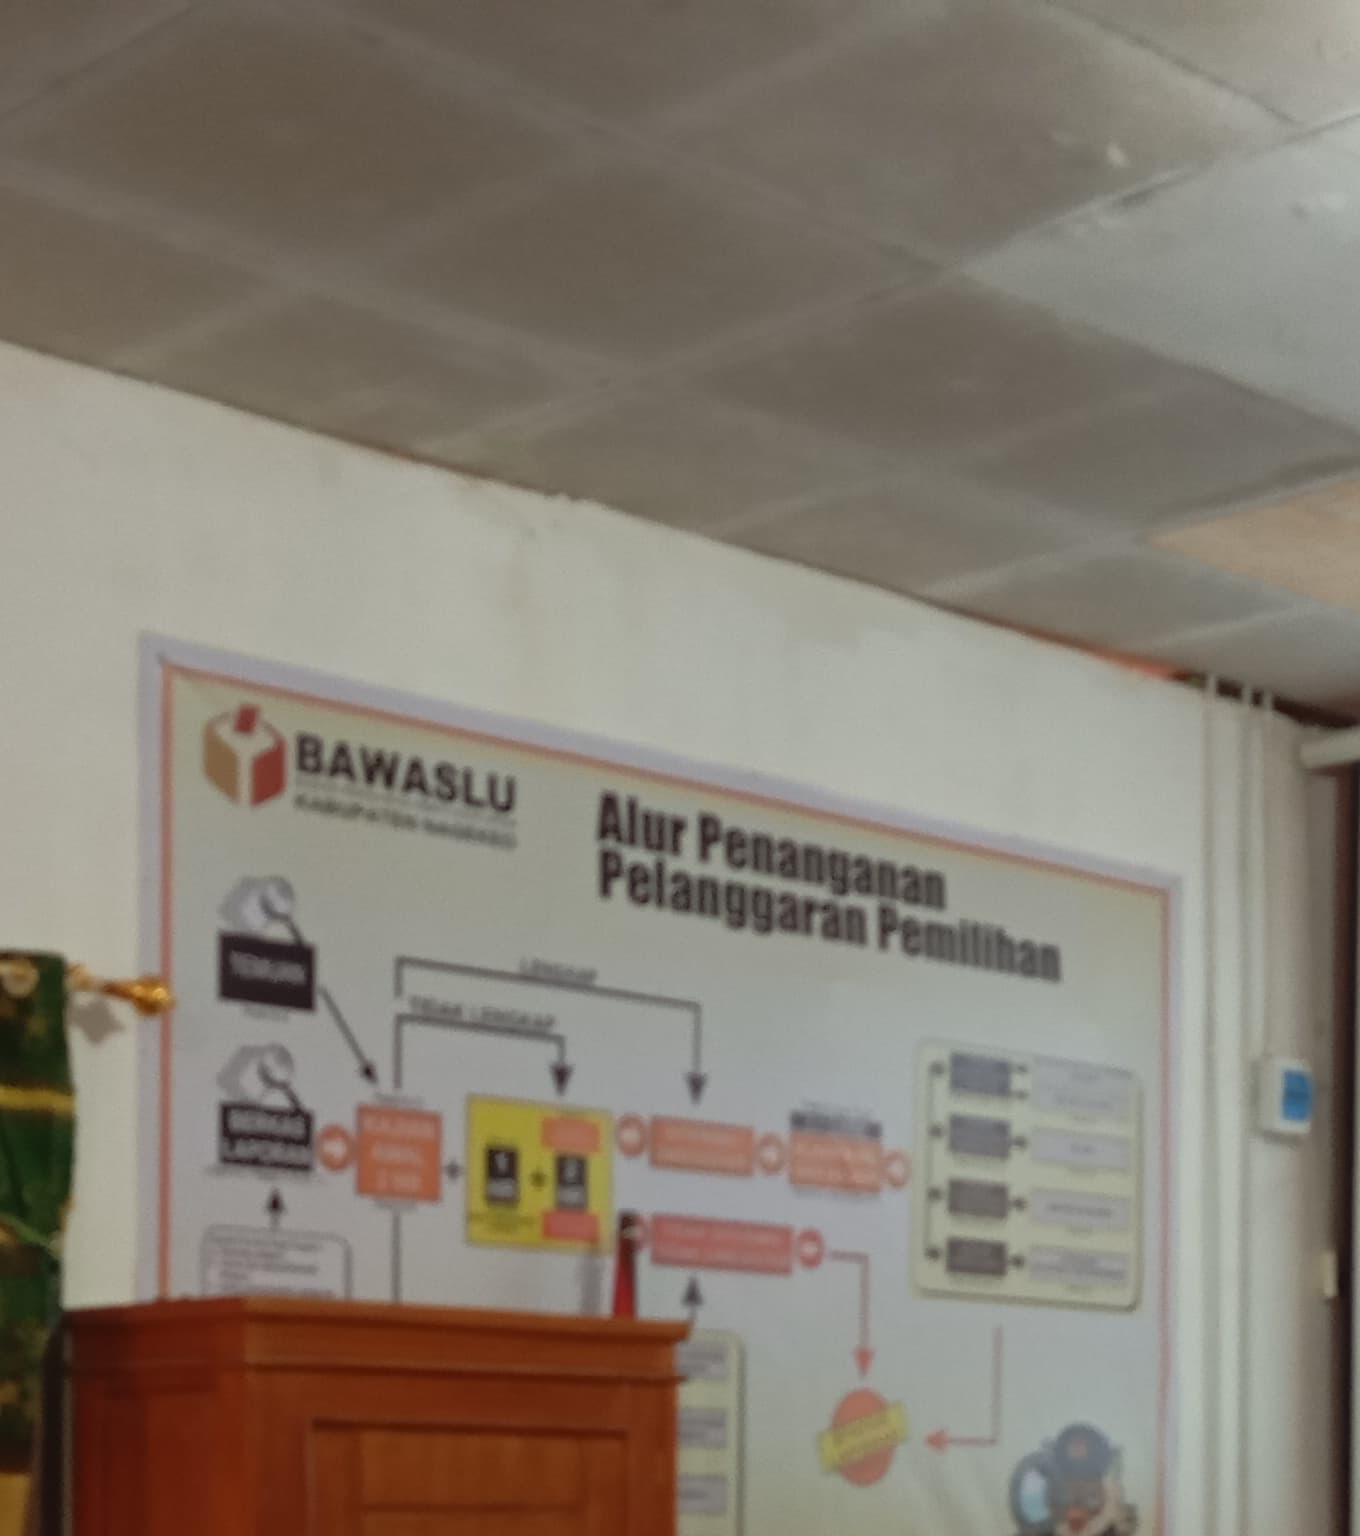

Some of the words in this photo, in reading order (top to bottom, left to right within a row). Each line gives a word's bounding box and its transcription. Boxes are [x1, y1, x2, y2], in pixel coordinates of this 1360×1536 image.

[296, 732, 517, 813] BAWASLU
[597, 792, 688, 854] Alur
[698, 812, 947, 910] Penanganan
[599, 851, 868, 946] Pelanggaran
[878, 903, 1063, 983] Pemilihan
